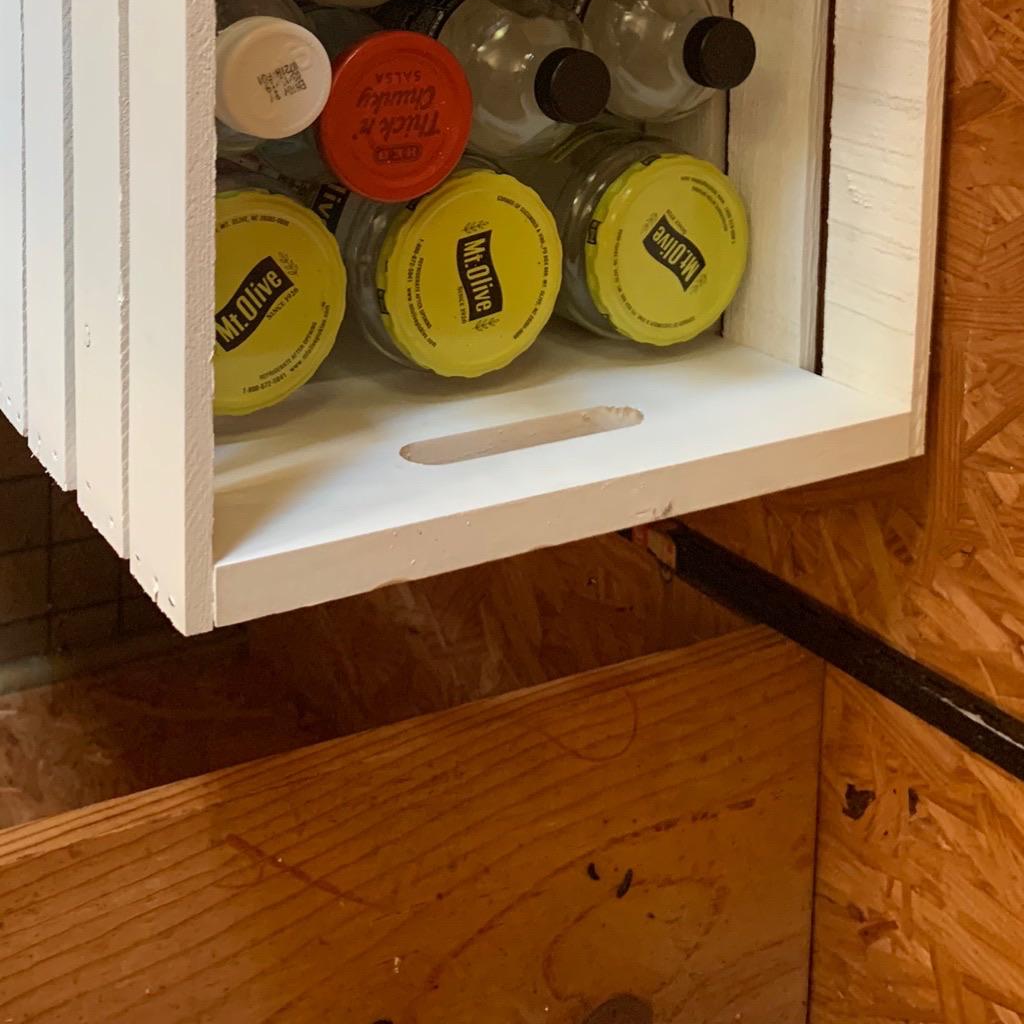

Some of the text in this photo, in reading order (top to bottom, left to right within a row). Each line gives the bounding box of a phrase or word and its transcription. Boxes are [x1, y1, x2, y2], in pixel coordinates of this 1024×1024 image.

[376, 71, 421, 82] SALSA
[356, 87, 436, 114] Chunky
[379, 112, 441, 142] Thick
